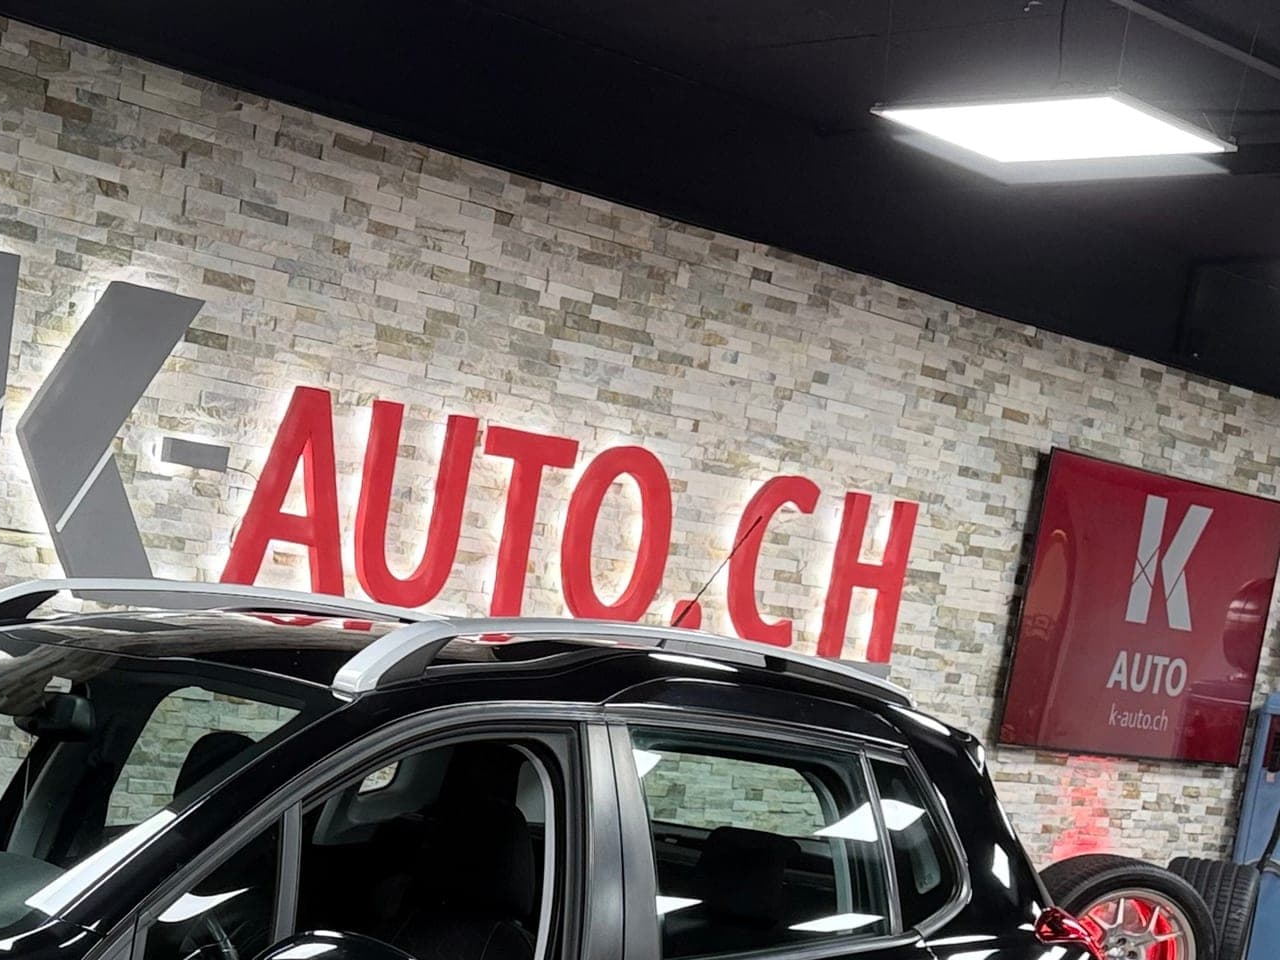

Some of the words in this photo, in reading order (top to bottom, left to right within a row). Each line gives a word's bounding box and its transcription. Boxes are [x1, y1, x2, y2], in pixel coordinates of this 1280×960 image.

[1125, 494, 1214, 632] K
[1106, 650, 1188, 697] AUTO
[1108, 703, 1169, 732] k-auto.ch
